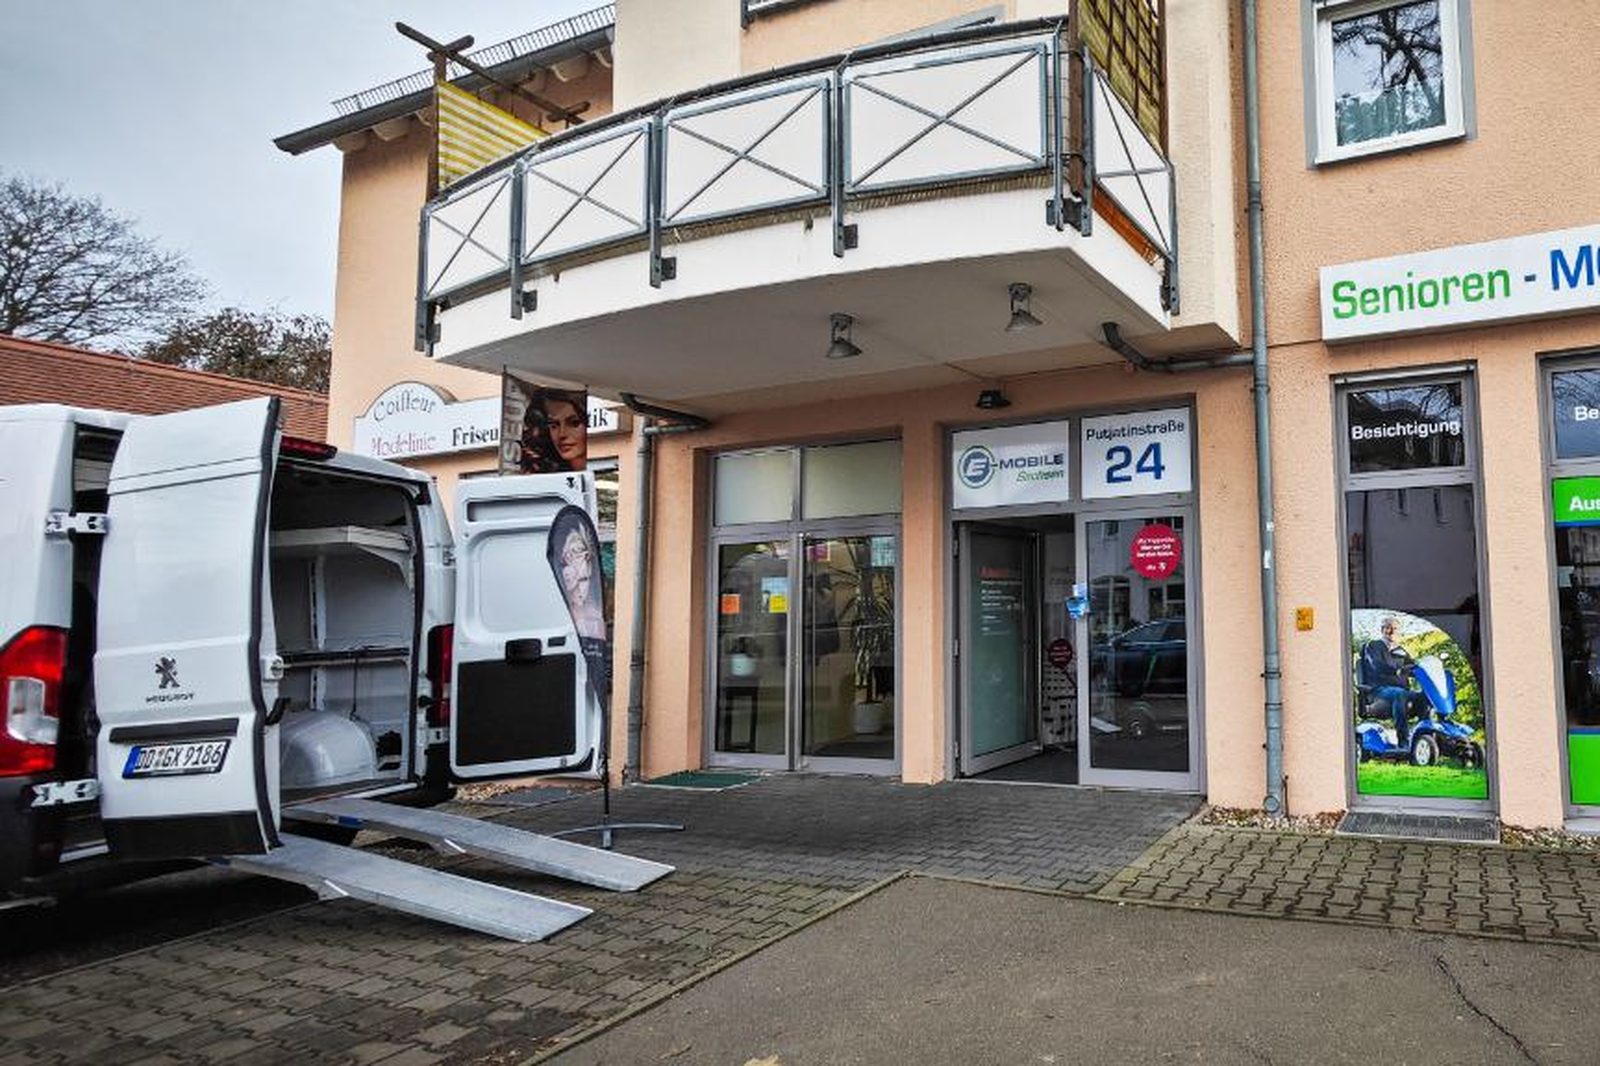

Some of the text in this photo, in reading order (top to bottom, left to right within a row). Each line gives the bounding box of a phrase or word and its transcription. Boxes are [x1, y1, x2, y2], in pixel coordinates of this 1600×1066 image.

[1332, 269, 1510, 320] Senioren
[1550, 244, 1600, 291] M
[1086, 420, 1185, 440] Putjatinstraße
[1351, 421, 1461, 440] Besichtigung
[1105, 442, 1165, 484] 24
